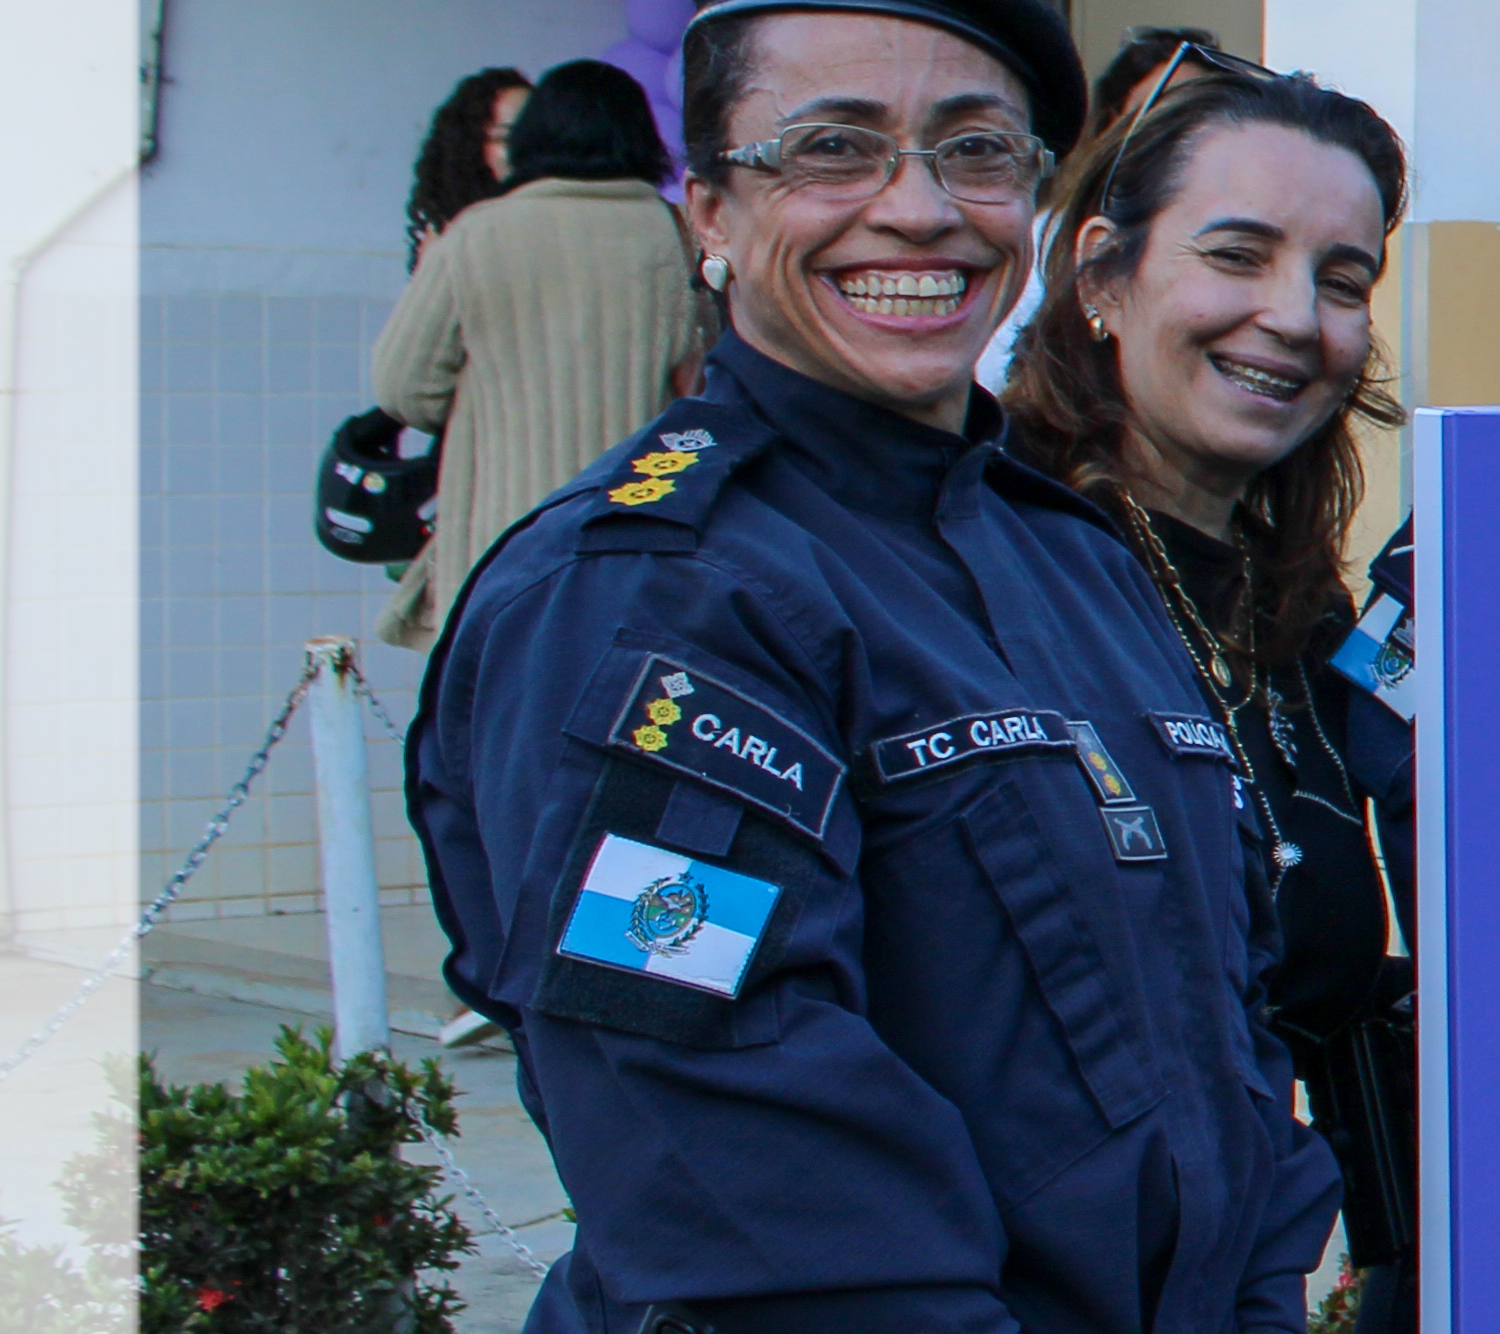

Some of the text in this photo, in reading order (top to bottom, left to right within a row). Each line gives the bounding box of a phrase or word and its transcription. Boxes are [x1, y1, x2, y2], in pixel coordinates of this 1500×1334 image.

[692, 713, 803, 791] CARLA
[907, 716, 1048, 766] TC CARLA
